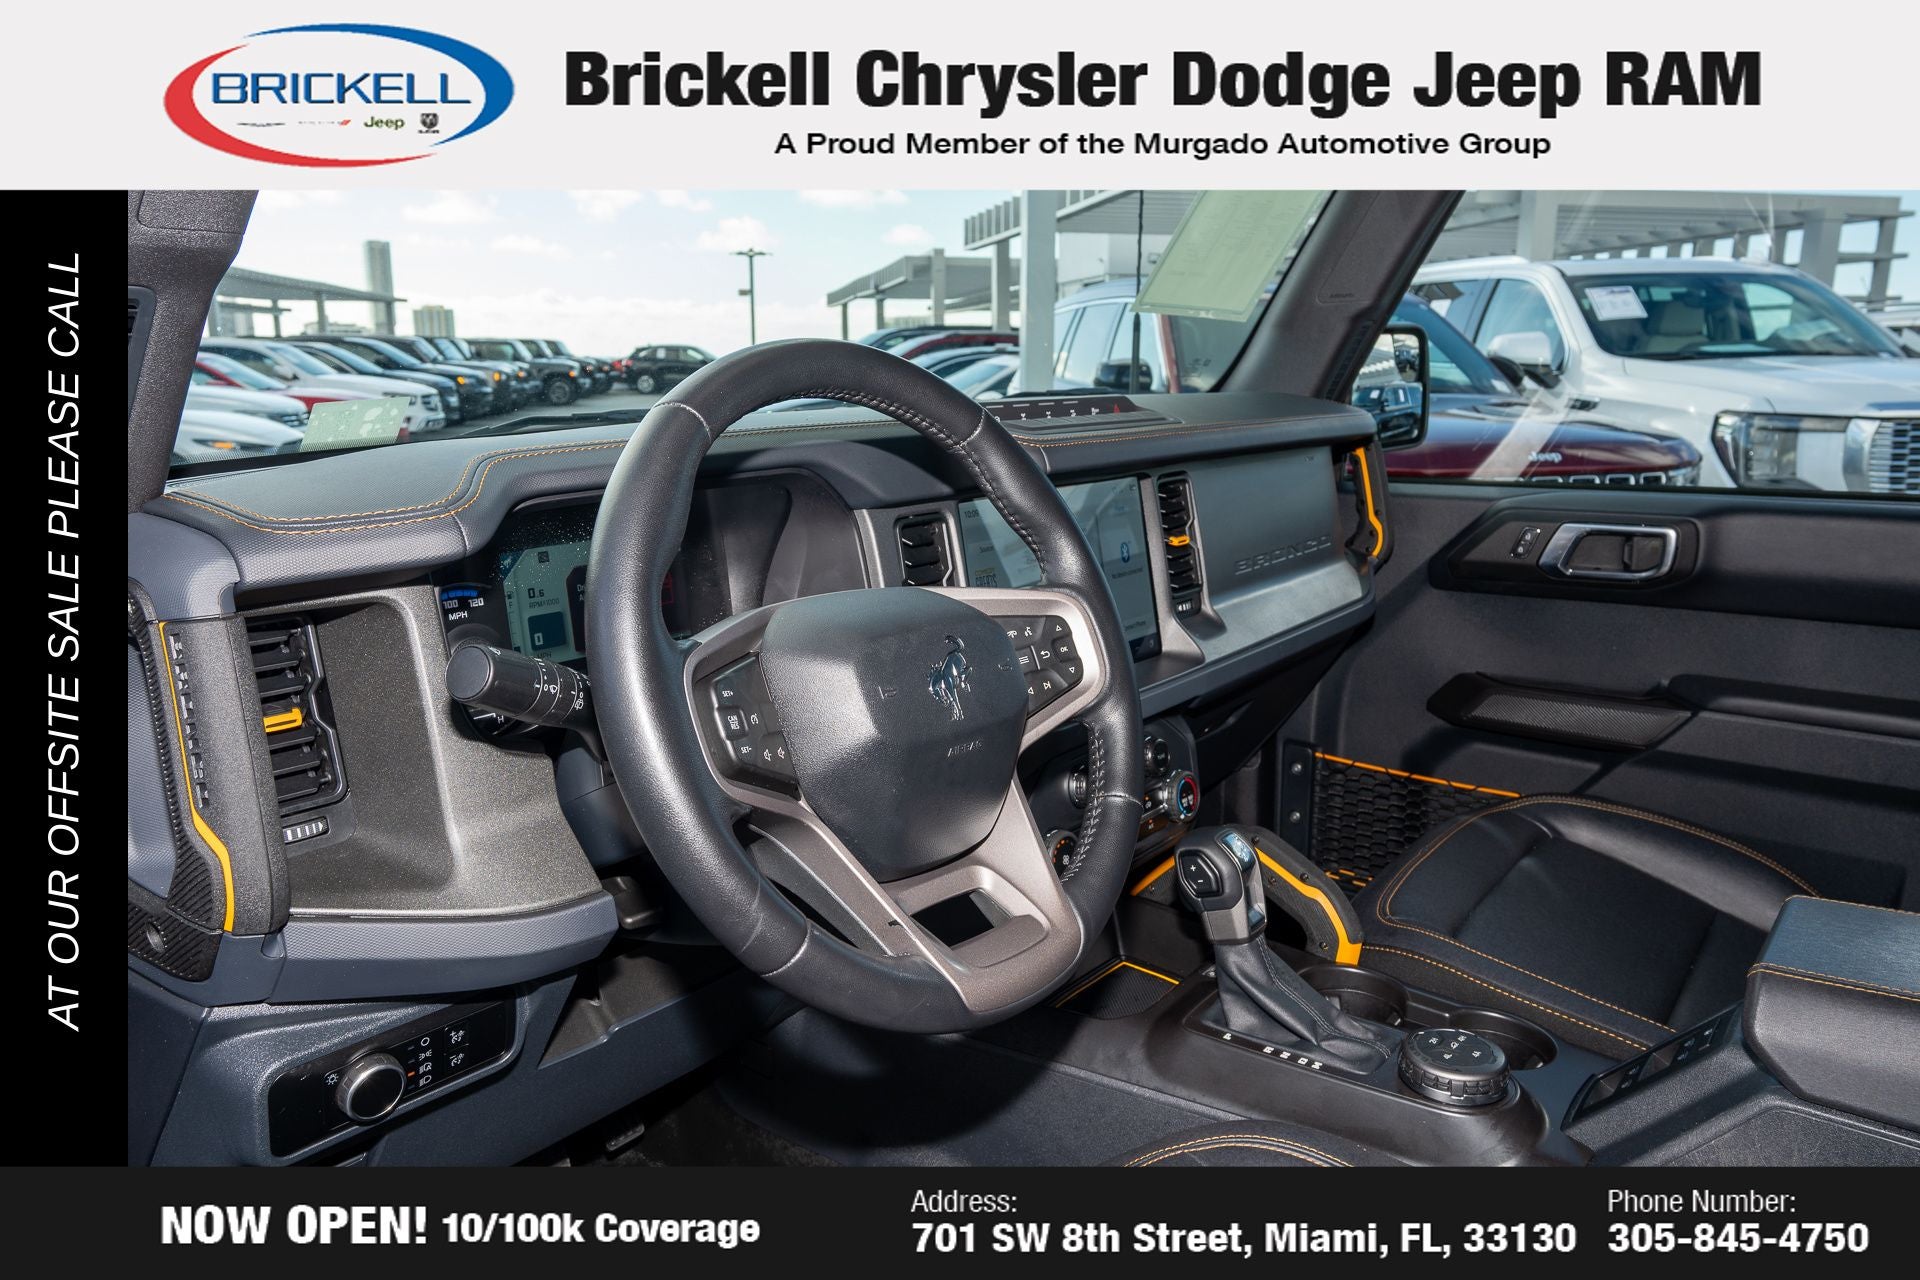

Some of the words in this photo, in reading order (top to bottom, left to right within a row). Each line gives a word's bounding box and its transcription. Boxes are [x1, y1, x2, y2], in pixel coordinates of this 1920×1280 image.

[1234, 533, 1331, 575] BRONCO
[443, 600, 458, 609] 100
[468, 597, 484, 607] 120
[448, 611, 468, 621] MPH
